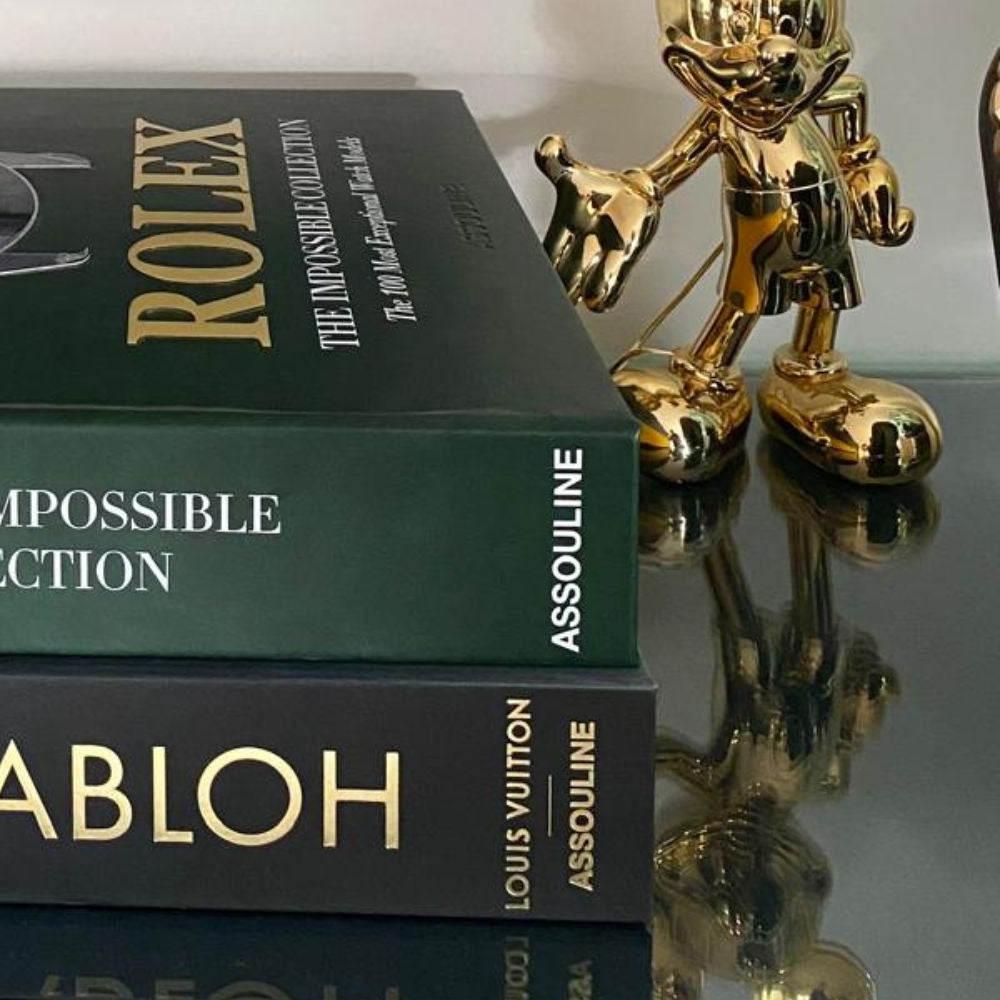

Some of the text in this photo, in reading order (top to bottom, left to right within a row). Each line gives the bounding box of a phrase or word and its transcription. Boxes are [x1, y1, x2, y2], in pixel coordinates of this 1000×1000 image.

[127, 117, 271, 348] ROLEX
[278, 118, 360, 350] THE IMPOSSIBLE COLLECTION
[371, 247, 402, 274] Most
[376, 274, 409, 296] 100
[383, 299, 417, 322] The
[550, 448, 583, 653] ASSOULINE
[506, 698, 532, 820] VUITTON
[568, 721, 596, 891] ASSOULINE
[505, 828, 531, 910] LOUIS
